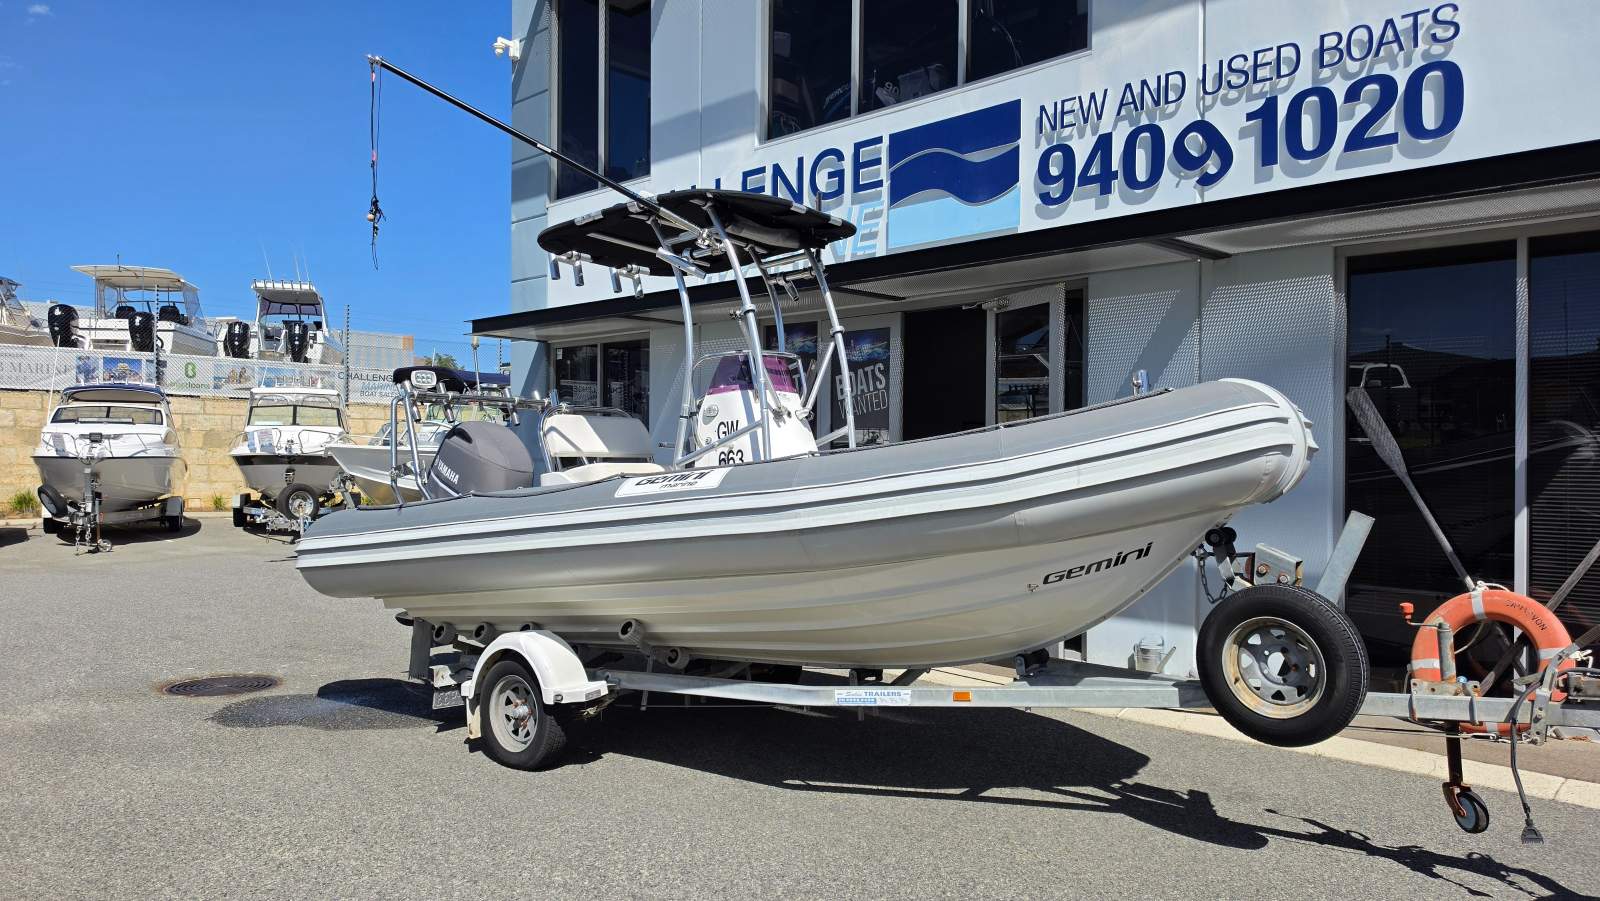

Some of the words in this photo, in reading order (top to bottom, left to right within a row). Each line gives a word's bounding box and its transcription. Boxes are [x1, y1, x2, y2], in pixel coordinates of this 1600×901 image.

[1039, 89, 1108, 135] NEW
[1116, 70, 1187, 117] AND
[1201, 42, 1301, 95] USED
[1319, 3, 1461, 69] BOATS
[1036, 119, 1234, 207] 9409
[1245, 60, 1465, 168] 1020
[717, 420, 739, 439] GW
[718, 449, 744, 465] 663
[437, 459, 459, 485] YAMAHA
